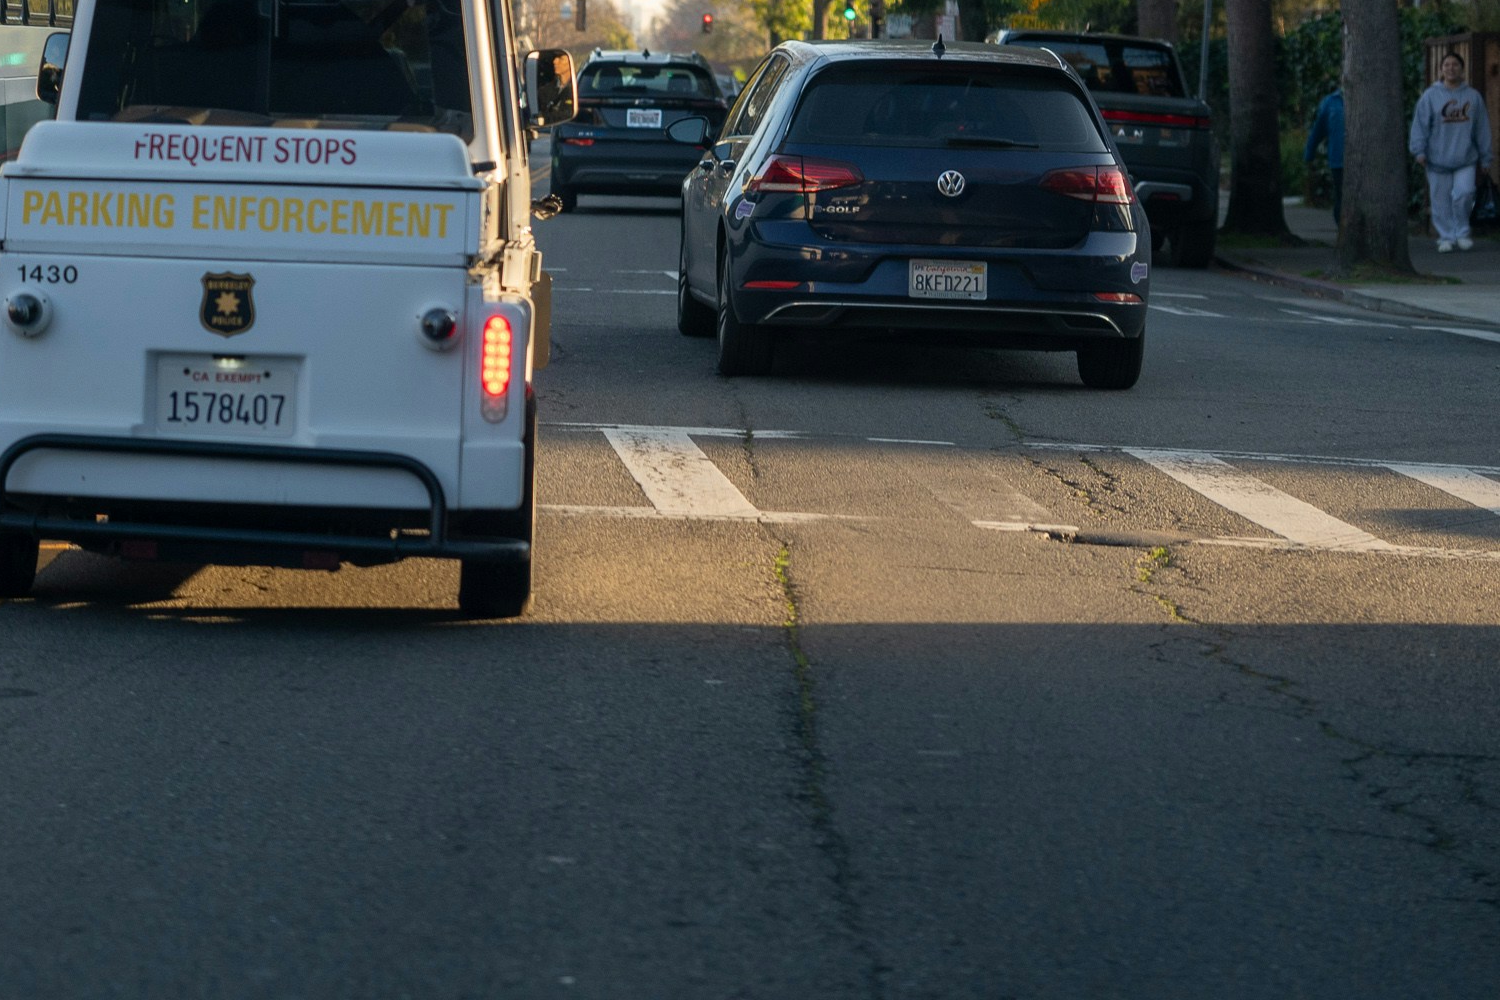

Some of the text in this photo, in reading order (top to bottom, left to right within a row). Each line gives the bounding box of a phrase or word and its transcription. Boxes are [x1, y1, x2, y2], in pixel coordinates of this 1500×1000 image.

[134, 133, 357, 167] FREQUENT STOPS
[22, 190, 455, 239] PARKING ENFORCEMENT
[17, 264, 78, 284] 1430
[212, 316, 243, 326] POLICE
[192, 371, 261, 384] CA EXEMPT
[167, 390, 285, 426] 1578407
